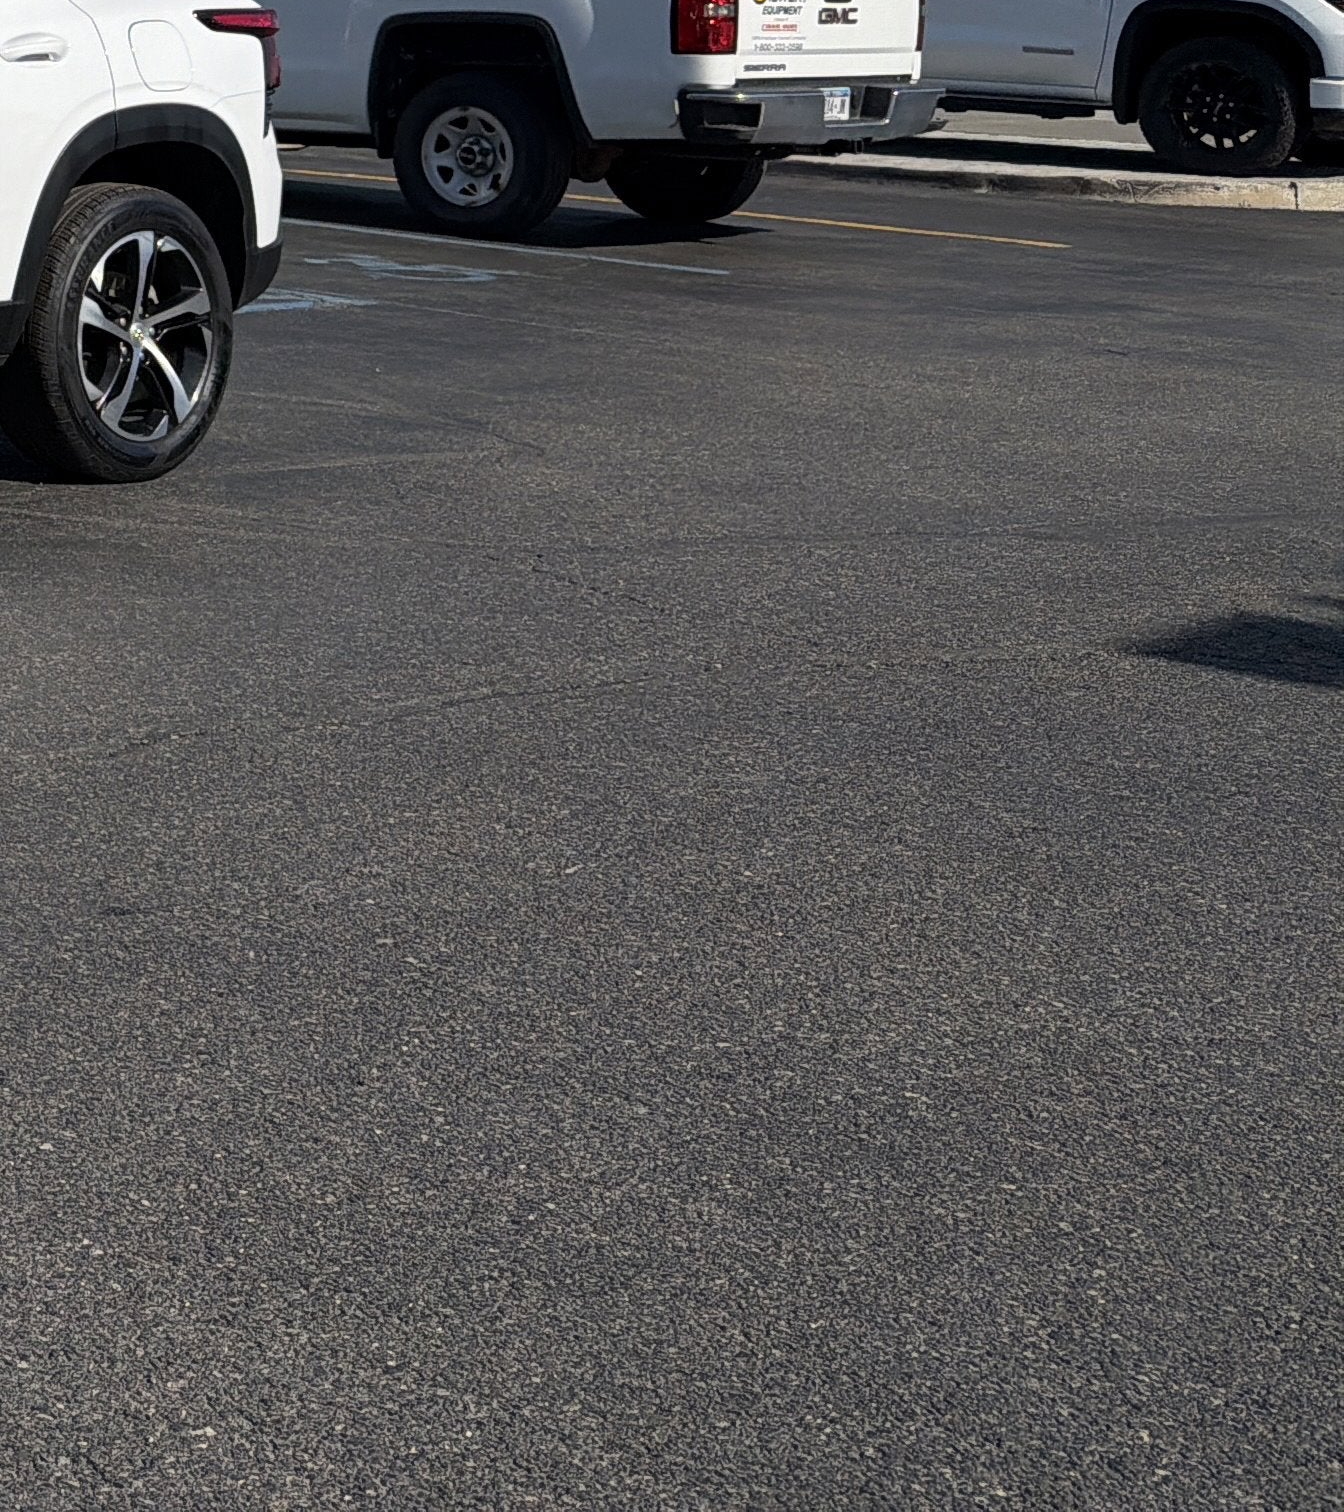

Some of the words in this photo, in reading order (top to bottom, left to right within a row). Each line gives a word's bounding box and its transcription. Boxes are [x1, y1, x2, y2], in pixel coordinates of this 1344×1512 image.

[762, 5, 804, 16] EQUIPMENT
[817, 7, 859, 25] GMC
[743, 63, 787, 73] SIERRA
